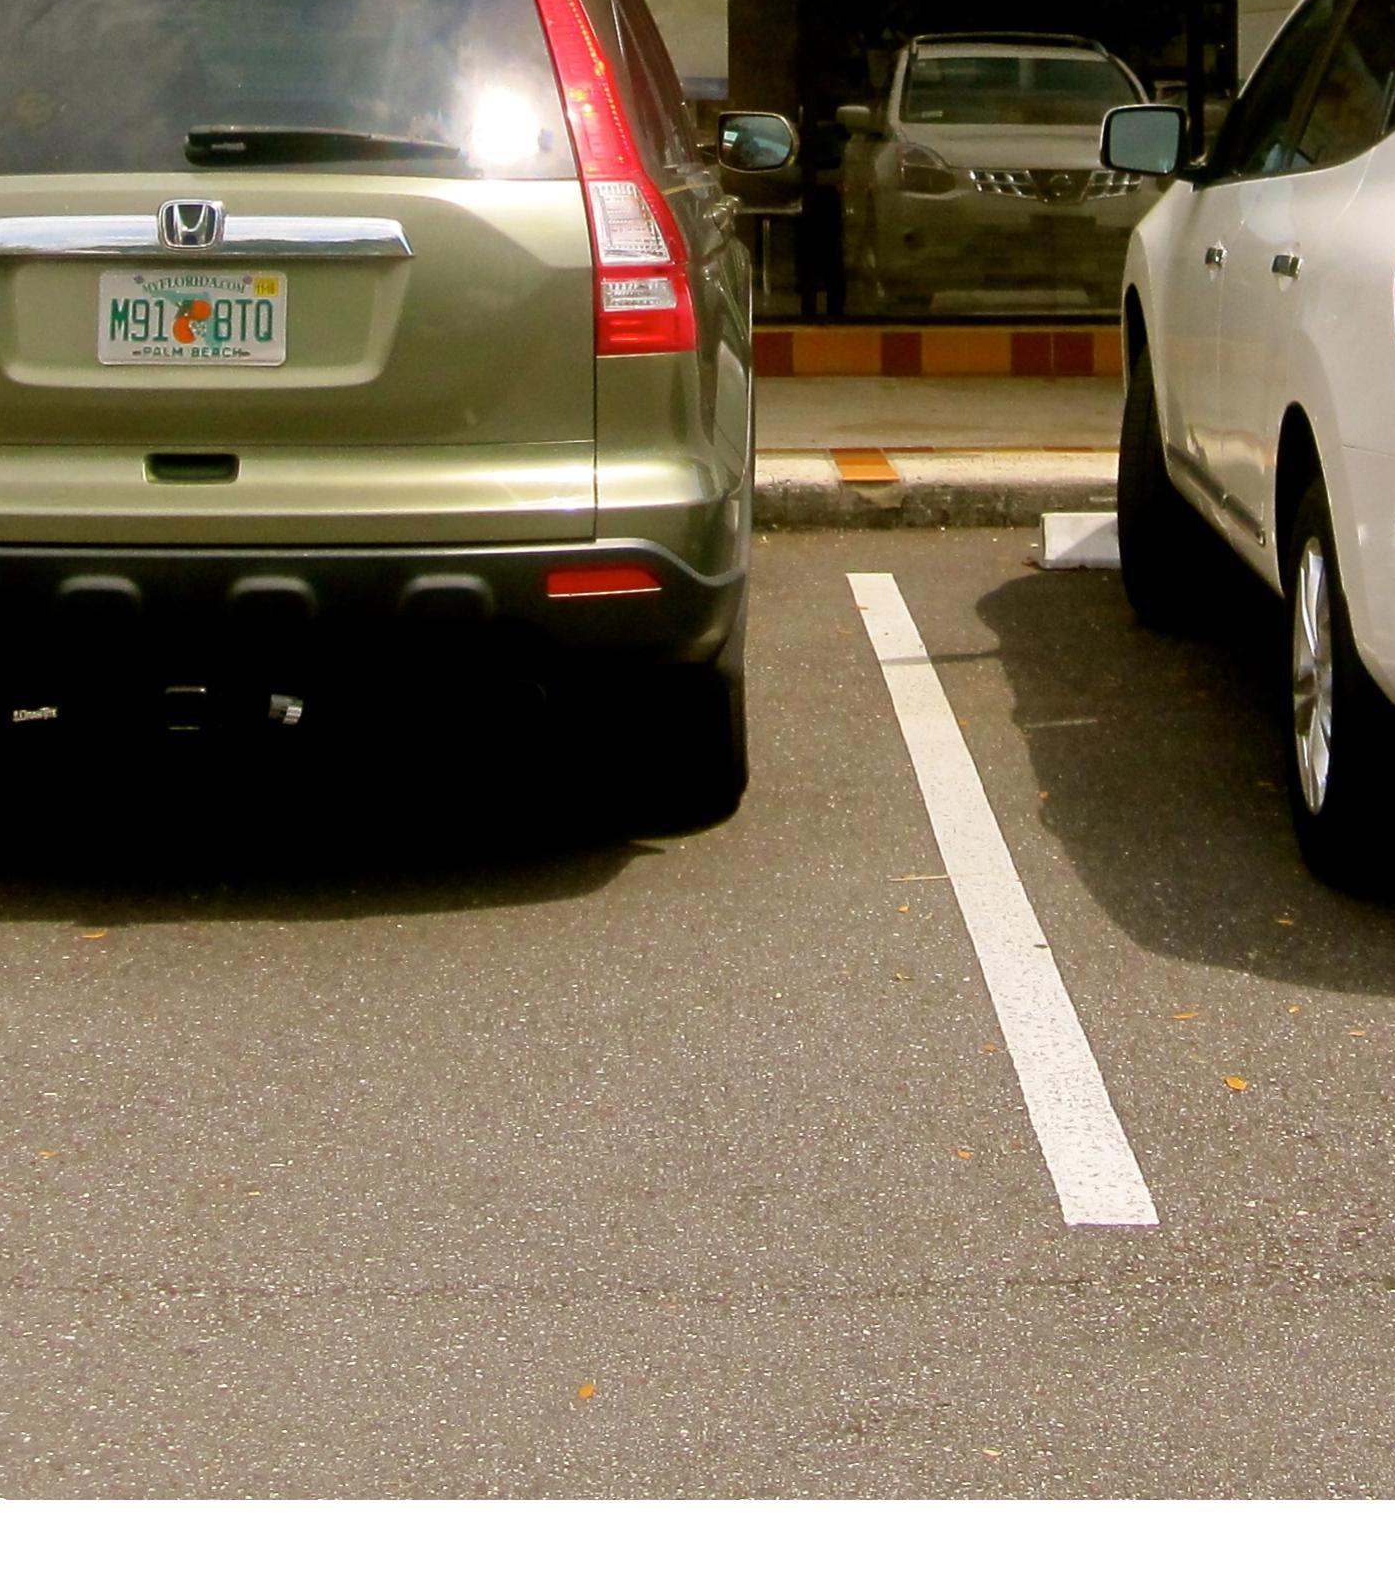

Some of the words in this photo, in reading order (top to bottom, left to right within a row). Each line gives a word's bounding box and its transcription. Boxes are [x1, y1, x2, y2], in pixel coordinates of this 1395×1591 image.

[109, 298, 169, 342] M91
[142, 346, 184, 358] PALM
[191, 346, 242, 358] BEACH
